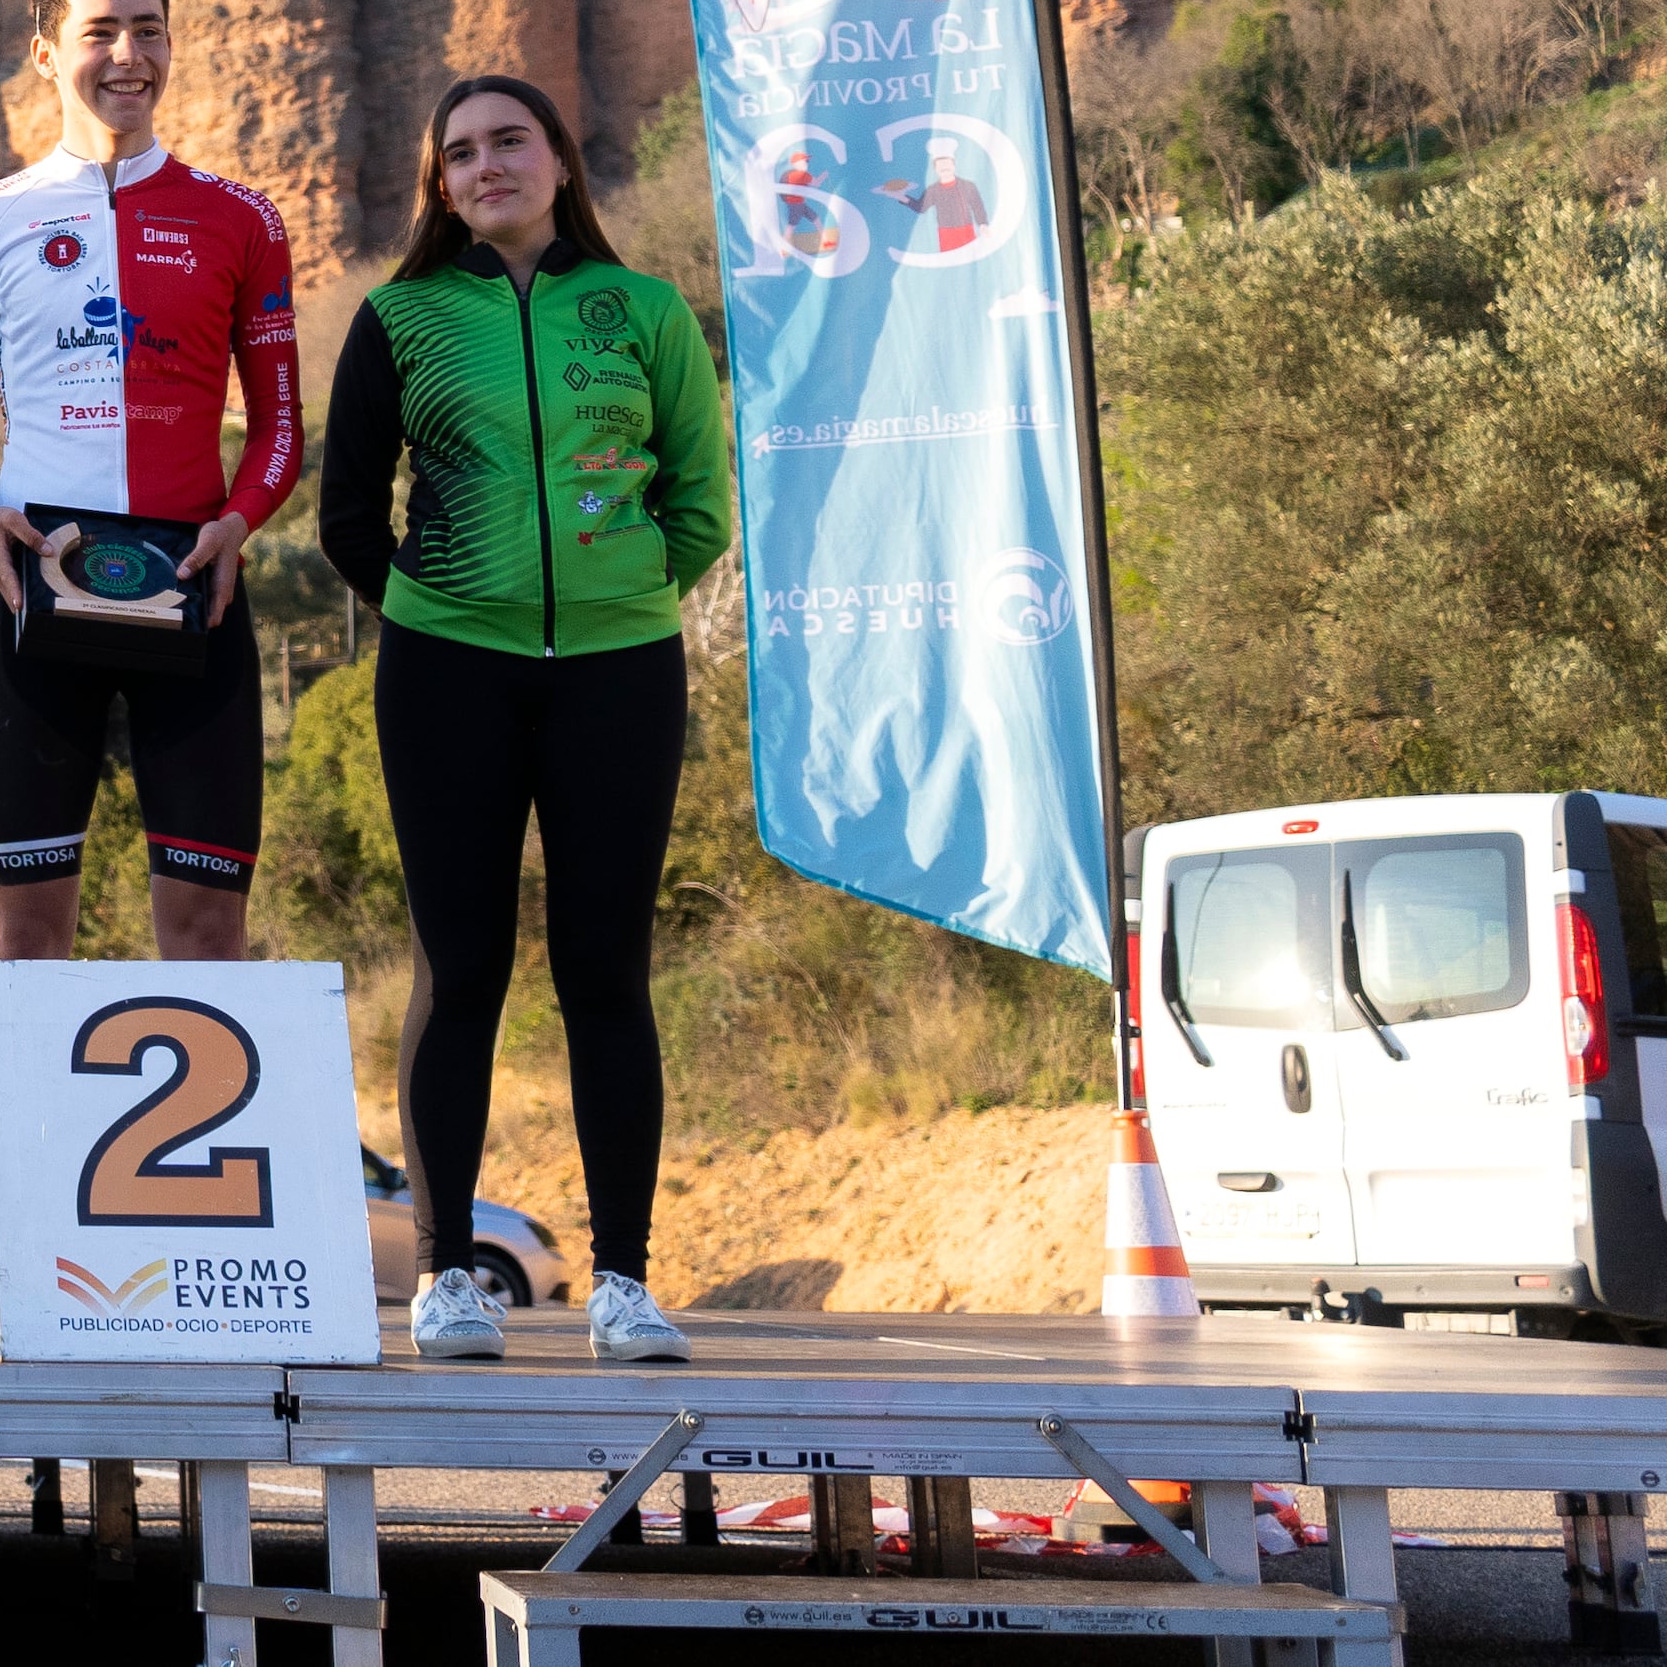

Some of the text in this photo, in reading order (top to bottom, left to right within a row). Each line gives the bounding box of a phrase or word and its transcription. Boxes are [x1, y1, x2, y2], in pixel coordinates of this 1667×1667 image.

[225, 186, 277, 243] BARRABEIG
[57, 360, 114, 374] COSTA
[277, 362, 292, 401] EBRE
[575, 404, 645, 428] Huesca
[165, 846, 241, 876] TORTOSA
[1486, 1087, 1549, 1107] Trafic
[71, 995, 275, 1229] 2
[173, 1258, 308, 1282] PROMO
[175, 1284, 311, 1309] EVENTS
[59, 1317, 314, 1334] PUBLICIDAD OCIO DEPORTE
[701, 1449, 875, 1470] GUIL
[769, 1609, 853, 1623] www.guil.es
[868, 1608, 1044, 1630] GUIL
